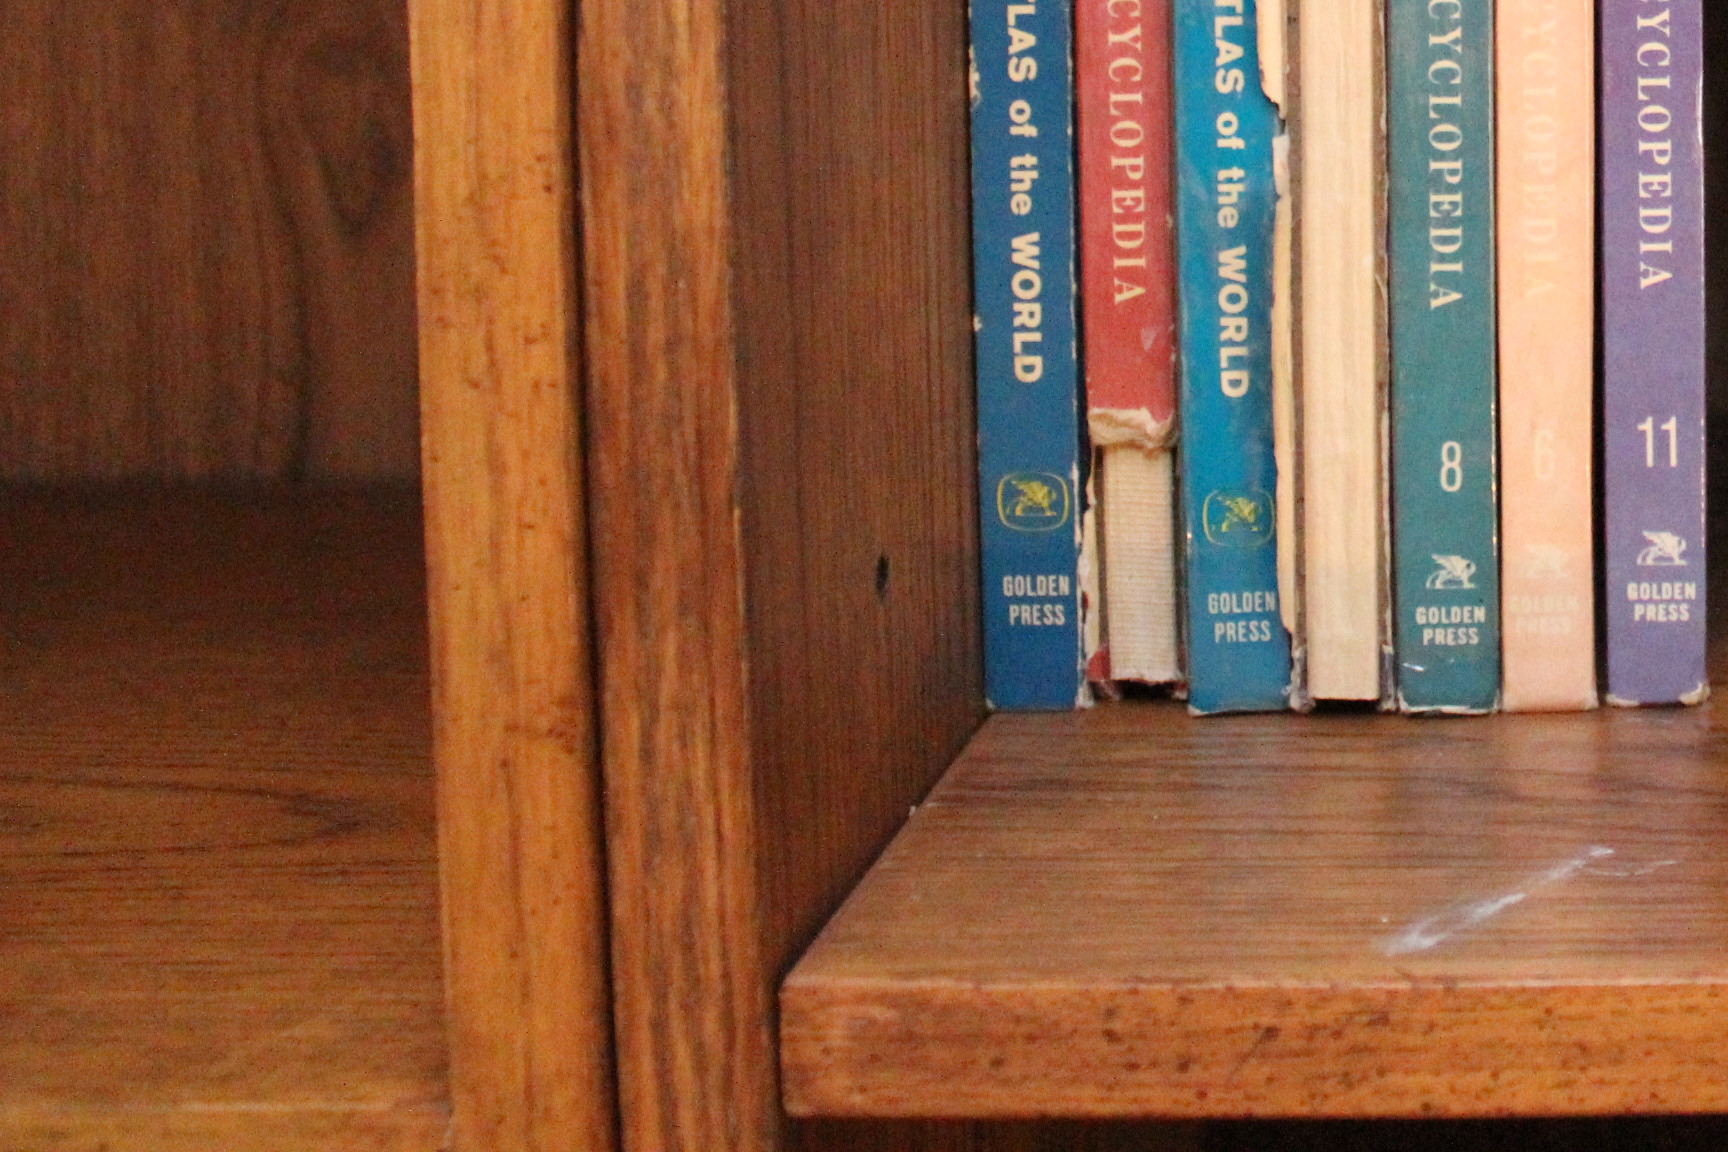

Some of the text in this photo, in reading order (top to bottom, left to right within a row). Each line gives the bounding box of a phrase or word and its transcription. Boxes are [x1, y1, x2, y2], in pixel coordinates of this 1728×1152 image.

[1009, 100, 1038, 137] of
[1216, 112, 1245, 150] of
[1009, 153, 1039, 215] the
[1217, 167, 1246, 228] the
[1010, 232, 1043, 383] WORLD
[1217, 246, 1249, 397] WORLD
[1637, 416, 1677, 468] 11
[1440, 441, 1463, 492] 8
[1003, 575, 1069, 597] GOLDEN
[1627, 582, 1696, 600] GOLDEN
[1009, 605, 1065, 626] PRESS
[1208, 592, 1276, 615] GOLDEN
[1416, 606, 1486, 625] GOLDEN
[1634, 604, 1690, 622] PRESS
[1214, 621, 1271, 643] PRESS
[1422, 627, 1479, 646] PRESS
